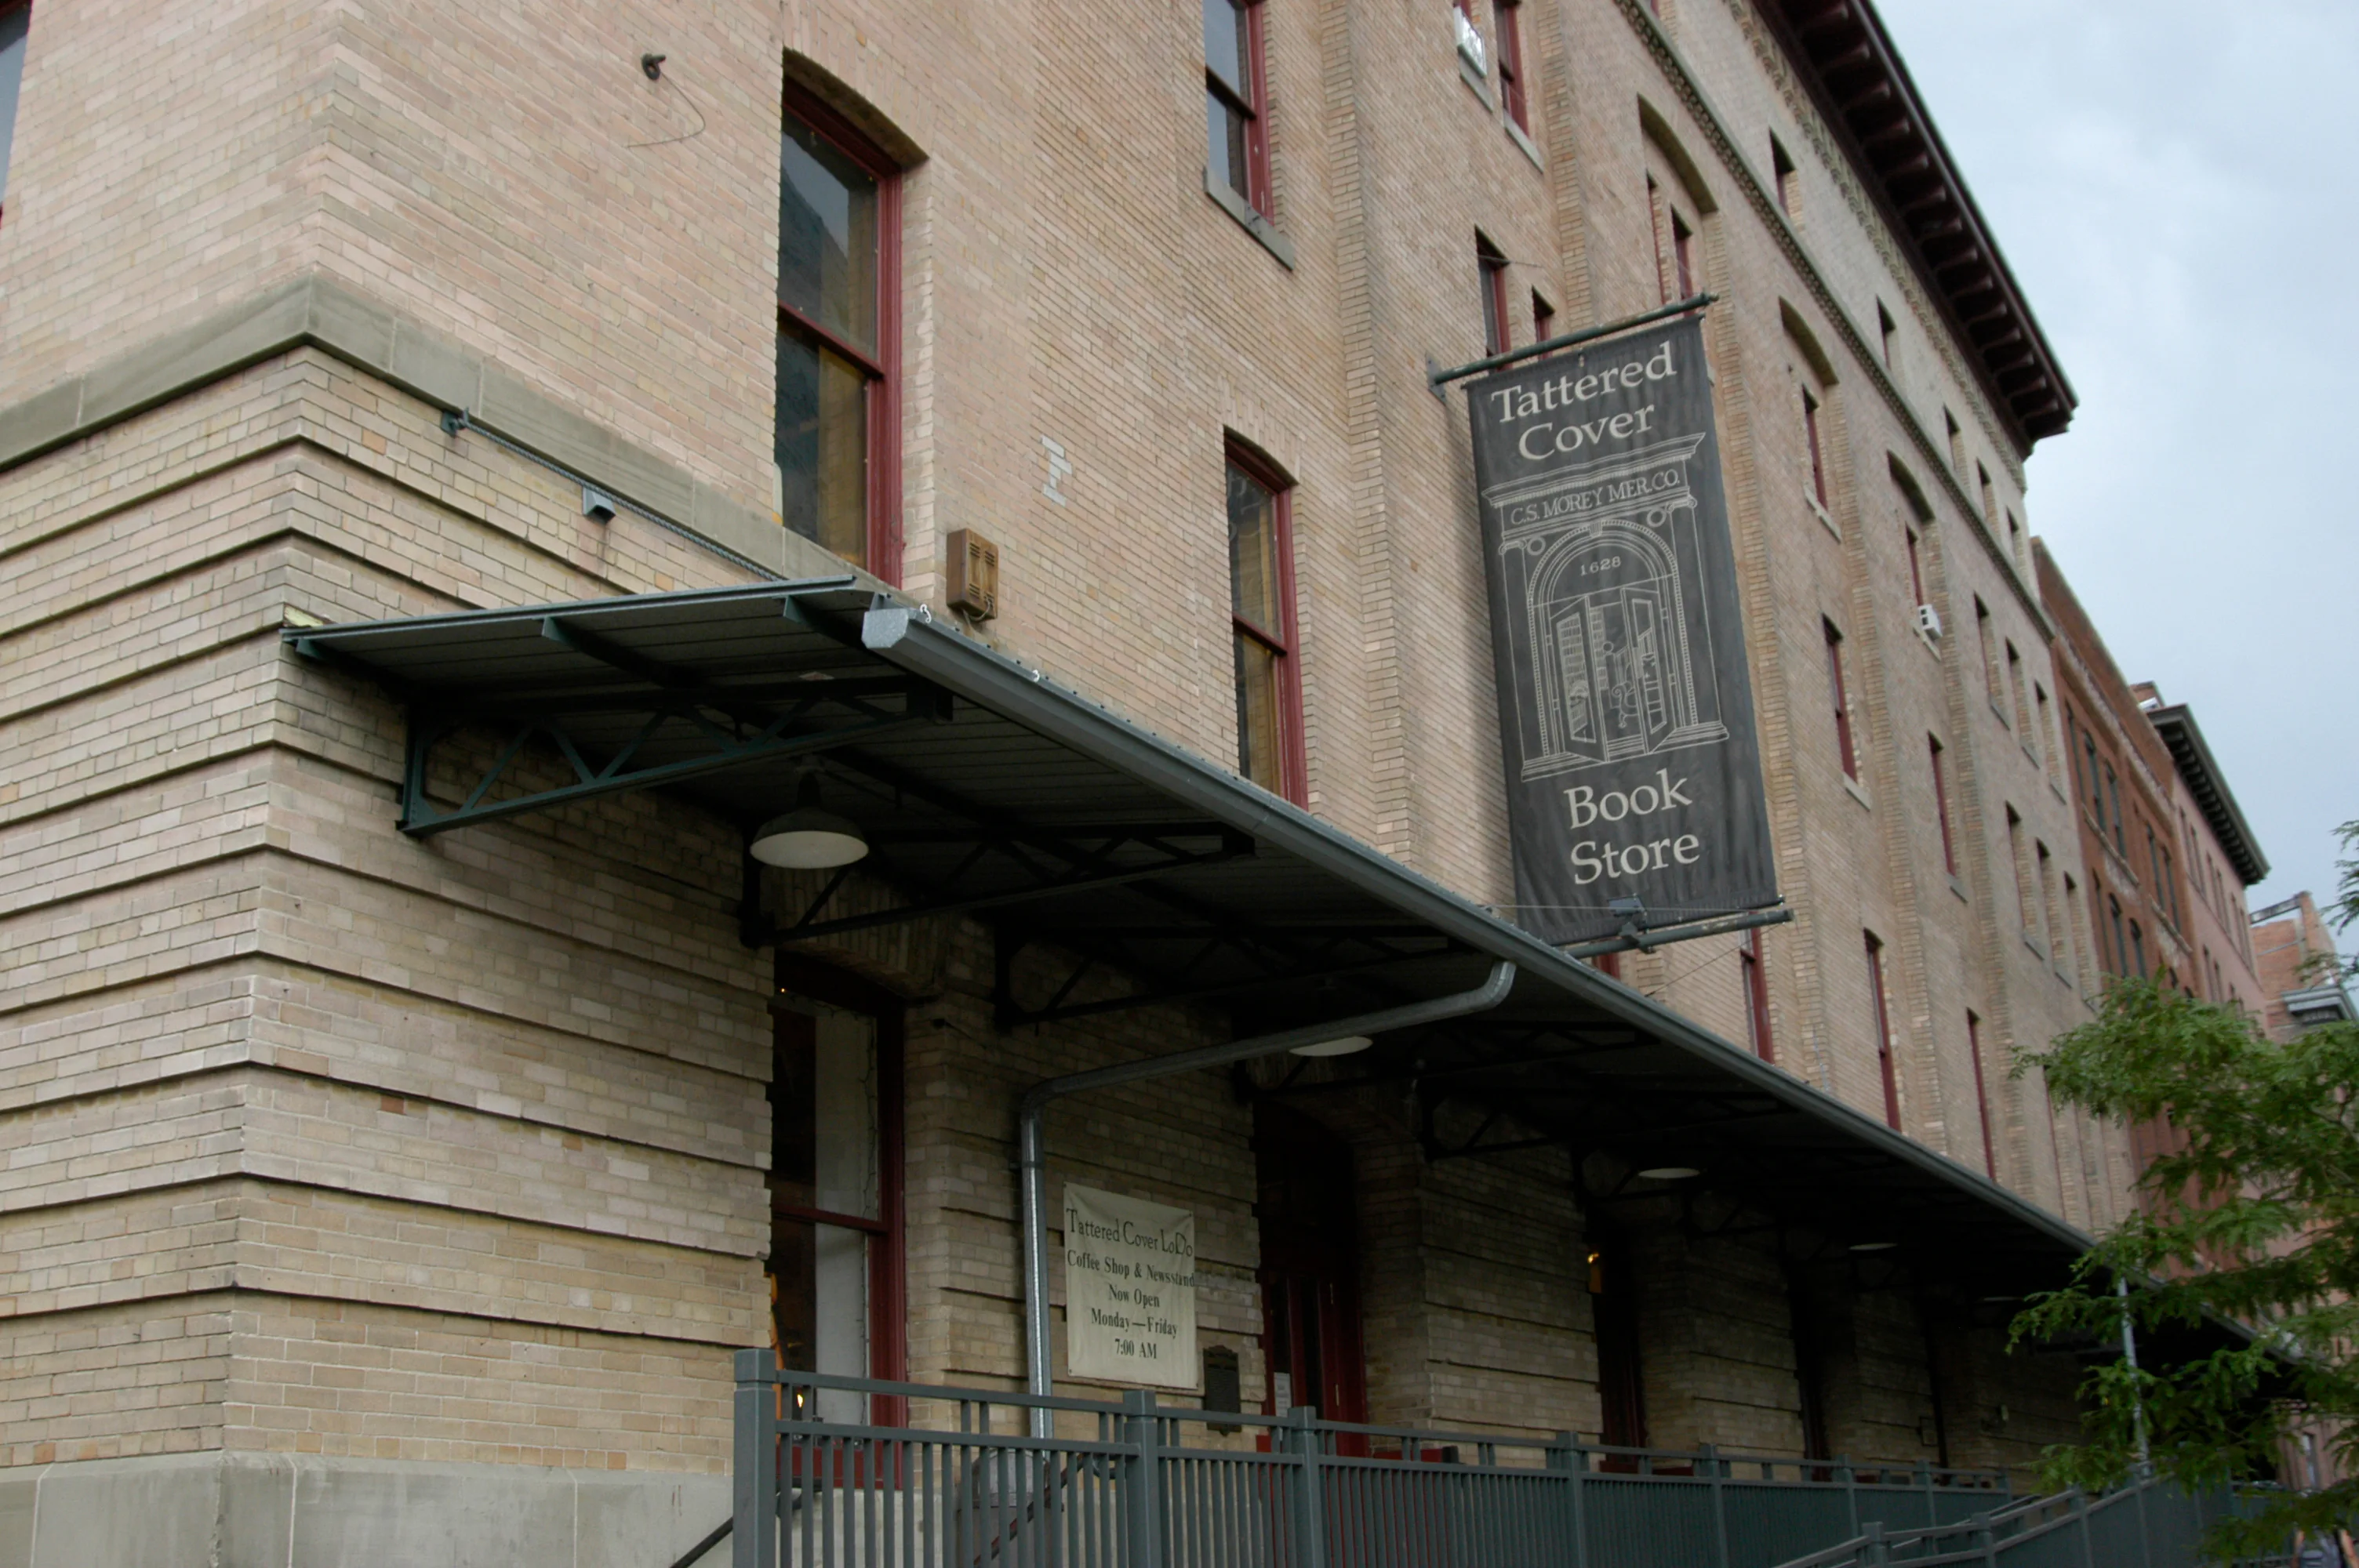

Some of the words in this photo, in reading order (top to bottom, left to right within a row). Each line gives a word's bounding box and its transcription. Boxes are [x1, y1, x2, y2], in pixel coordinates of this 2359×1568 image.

[1490, 339, 1677, 423] Tattered
[1518, 403, 1655, 460] Cover
[1543, 488, 1603, 518] MOREY
[1579, 556, 1622, 576] 1628
[1563, 768, 1692, 829] Book
[1571, 833, 1700, 884] Store
[1067, 1208, 1120, 1242] Tattered
[1123, 1221, 1158, 1250] Cover
[1160, 1229, 1193, 1257] LoDo
[1067, 1249, 1100, 1271] Coffee
[1104, 1256, 1129, 1279] Shop
[1134, 1262, 1142, 1278] &
[1147, 1264, 1195, 1287] Newsstand
[1109, 1283, 1129, 1301] Now
[1134, 1288, 1160, 1308] Open
[1115, 1338, 1135, 1356] 7:00
[1140, 1341, 1157, 1359] AM
